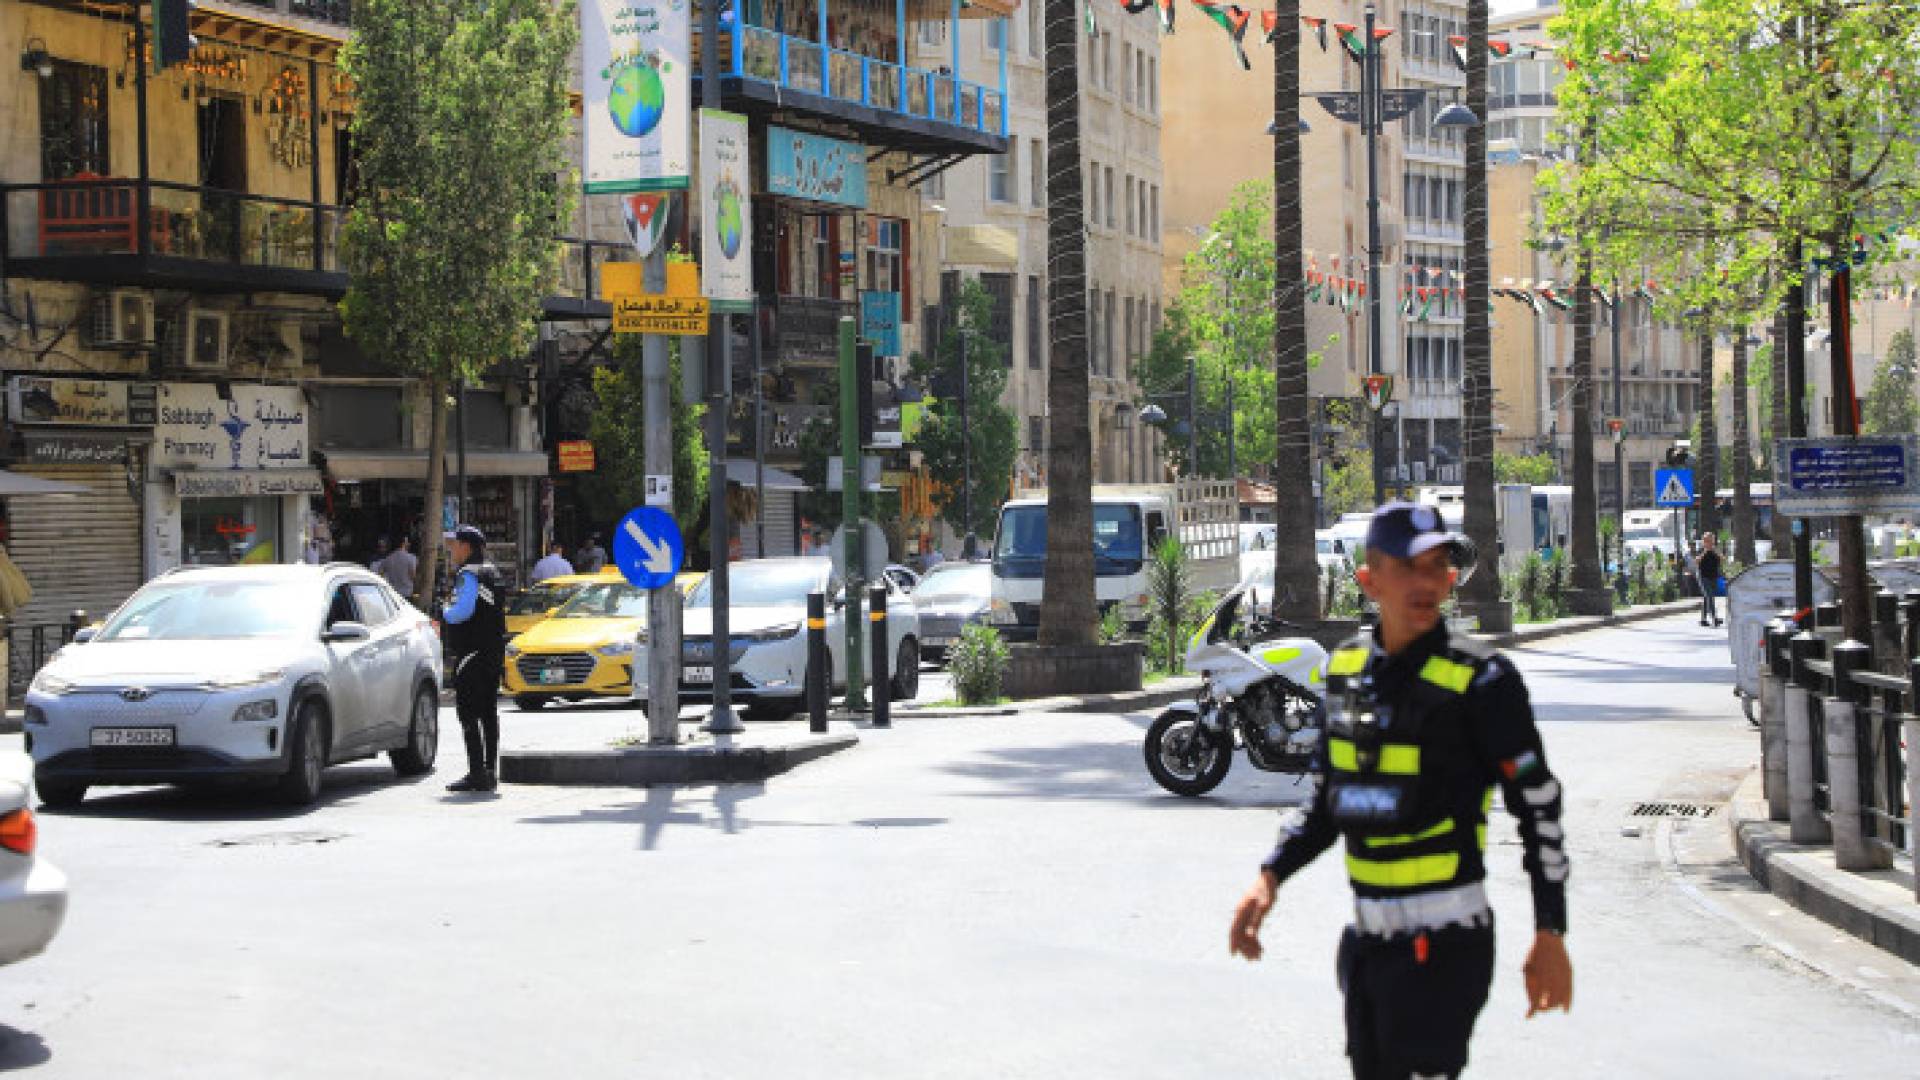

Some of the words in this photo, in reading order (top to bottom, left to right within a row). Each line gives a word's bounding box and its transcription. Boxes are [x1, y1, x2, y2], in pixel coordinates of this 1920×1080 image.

[161, 407, 215, 429] Sabbagh
[255, 399, 304, 430] صيدلية
[164, 439, 216, 460] Pharmacy
